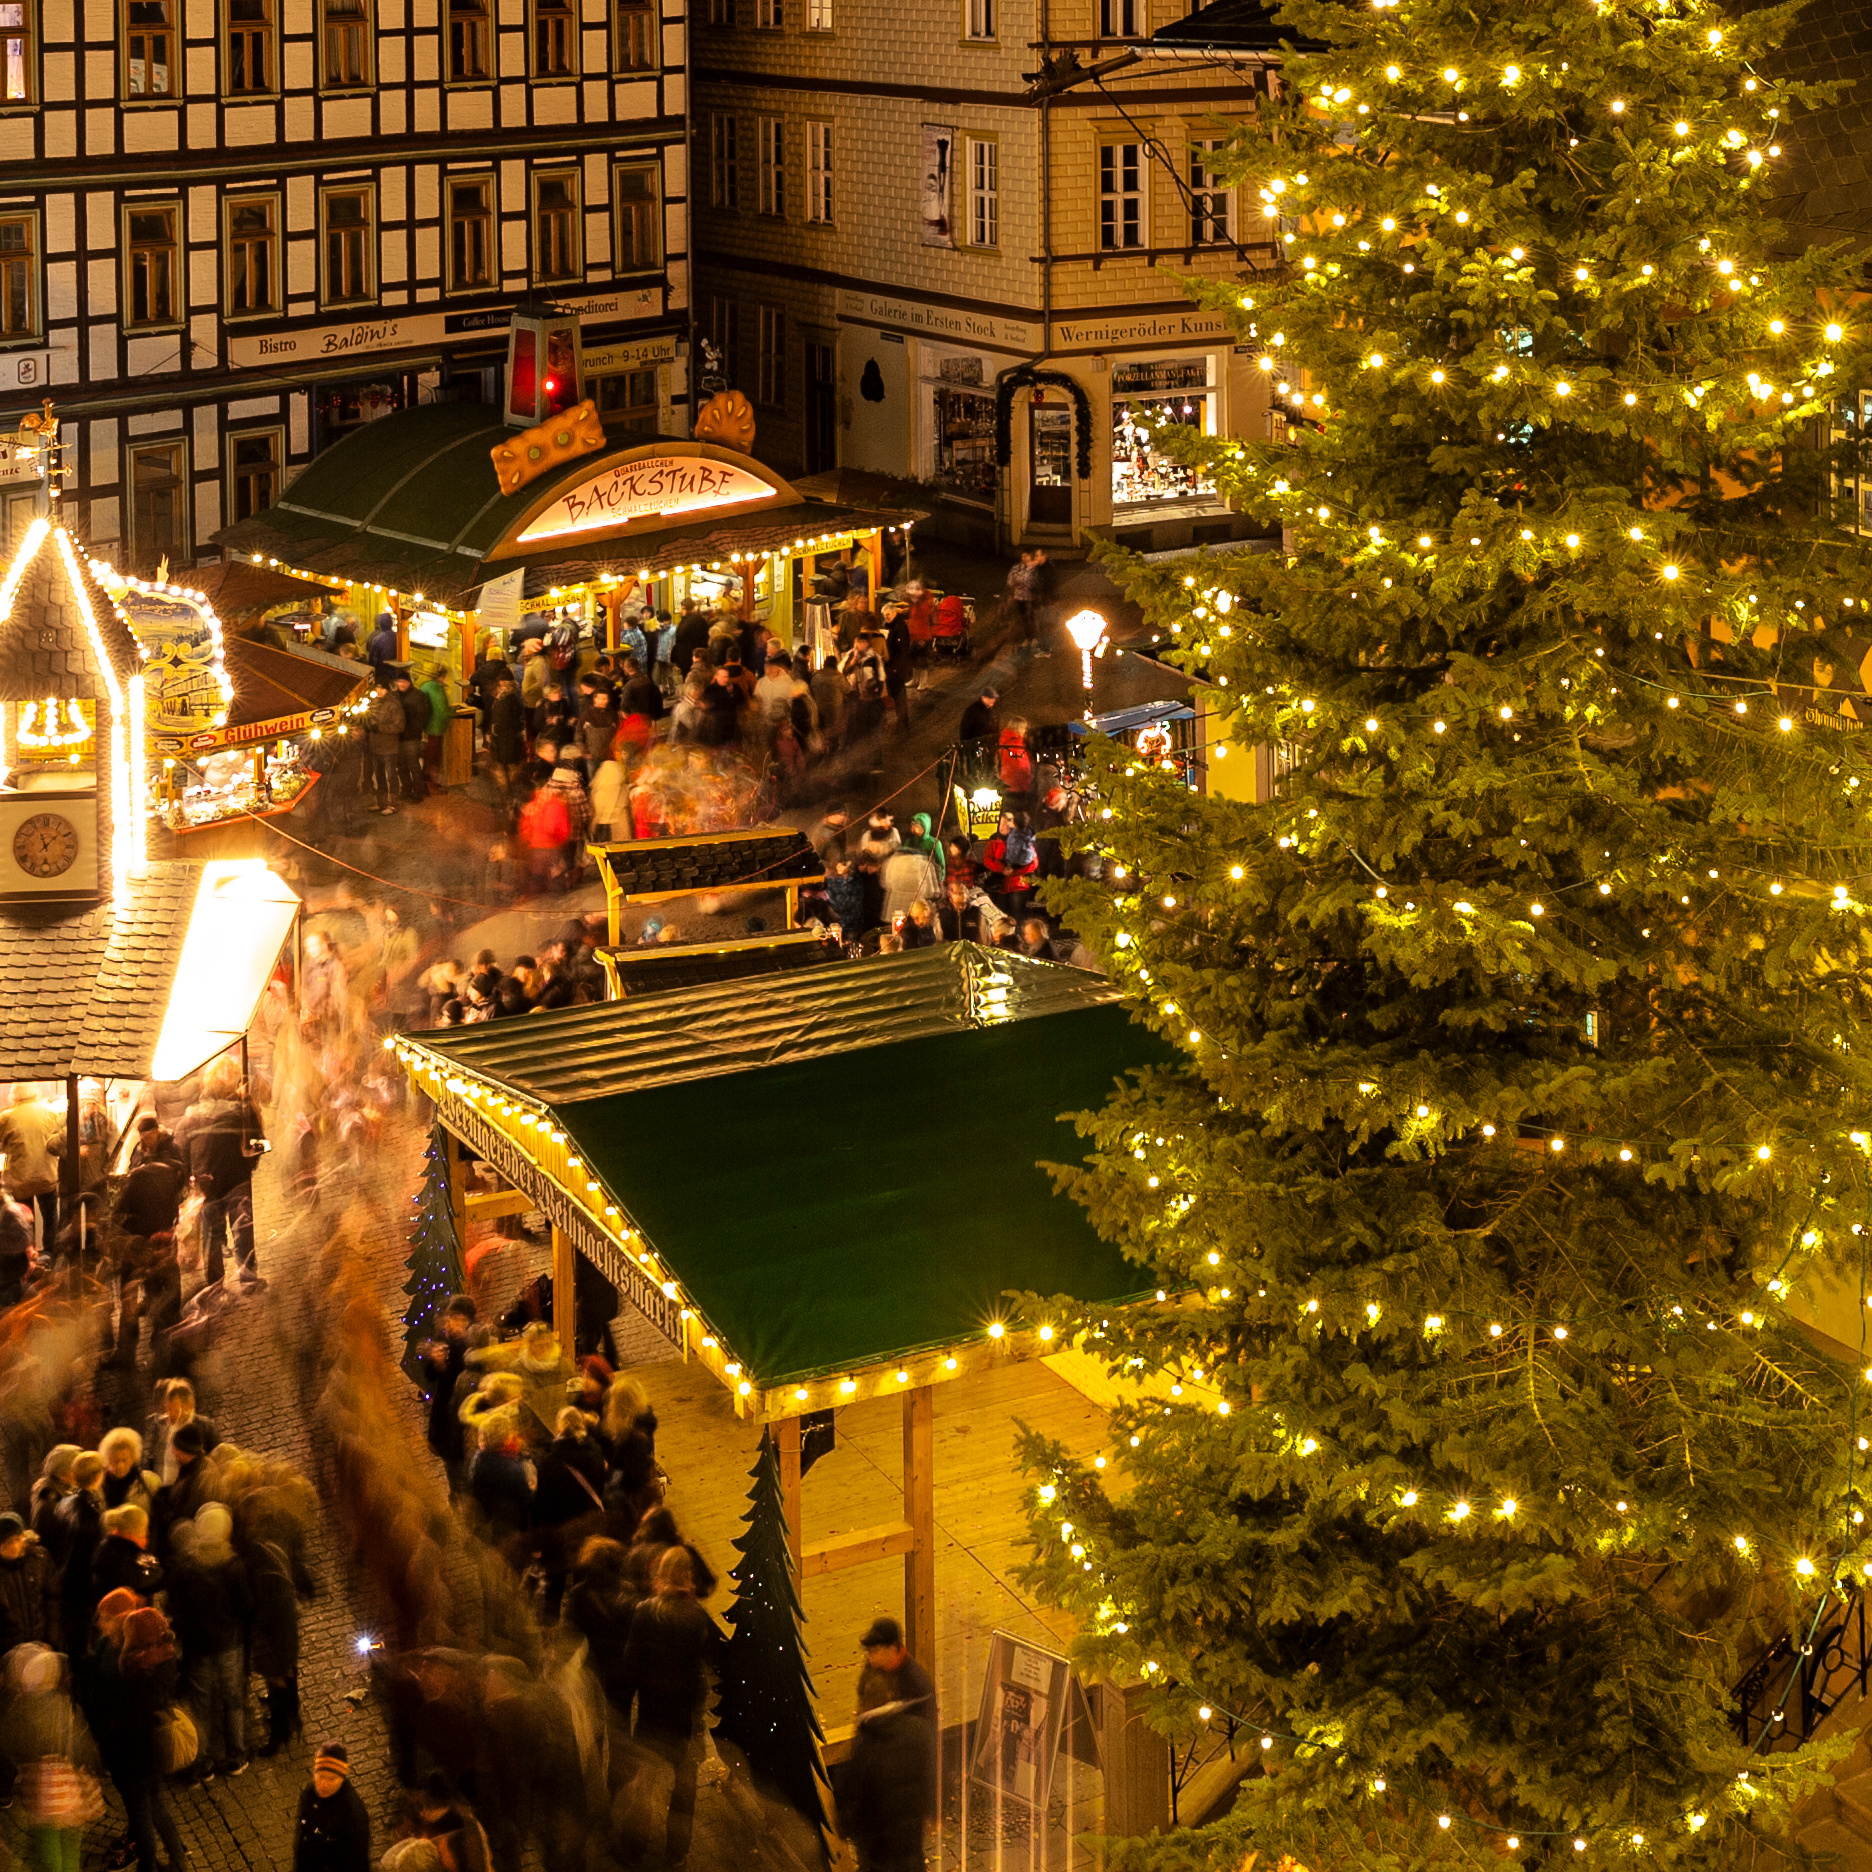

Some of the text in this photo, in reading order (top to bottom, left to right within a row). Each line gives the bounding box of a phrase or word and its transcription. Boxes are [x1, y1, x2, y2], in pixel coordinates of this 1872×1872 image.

[463, 314, 511, 328] Coffee House
[870, 299, 908, 321] Galerie
[910, 311, 924, 325] im
[927, 309, 962, 332] Ersten
[965, 317, 996, 338] Stock
[1060, 319, 1174, 344] Wernigeröder
[259, 338, 297, 355] Bistro
[320, 320, 398, 354] Baldini's
[652, 344, 671, 358] Uhr
[562, 466, 734, 525] BACKSTUBE
[225, 715, 305, 744] Glühwein
[439, 1091, 535, 1195] Wernigeröder
[536, 1172, 684, 1346] Weihnachtsmarkt
